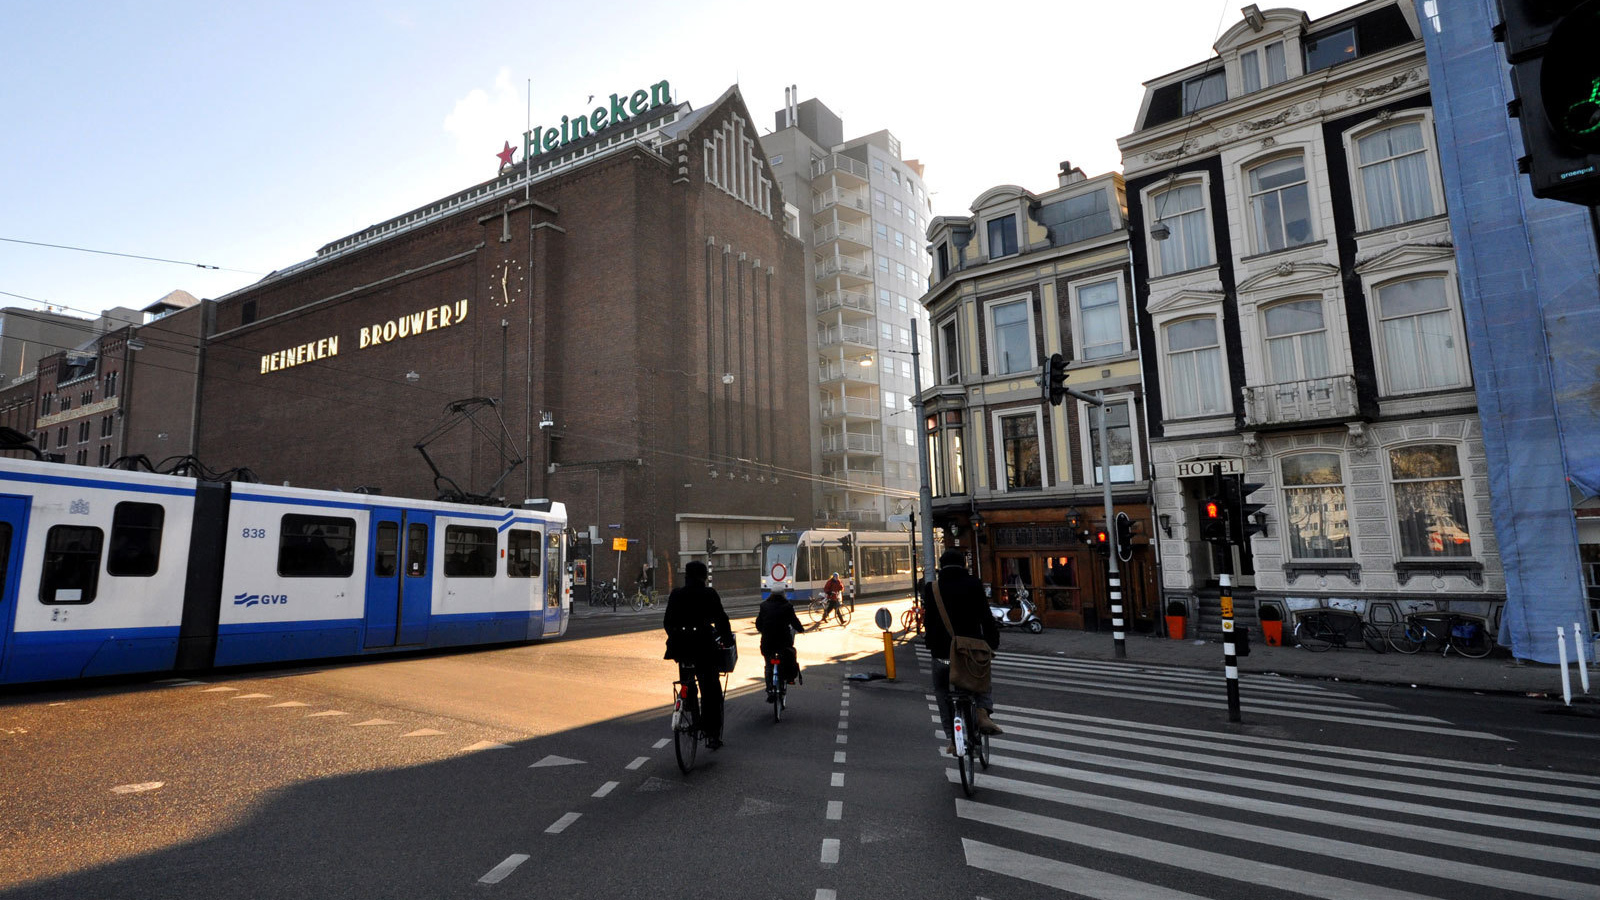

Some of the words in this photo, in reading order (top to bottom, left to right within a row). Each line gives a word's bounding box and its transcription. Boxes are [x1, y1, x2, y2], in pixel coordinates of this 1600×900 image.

[522, 79, 671, 161] Heineken
[260, 336, 339, 375] HEINEKEN
[359, 298, 469, 349] BROUWERIJ
[1178, 460, 1239, 476] HOTEL
[242, 528, 266, 539] 838
[261, 594, 288, 605] GVB
